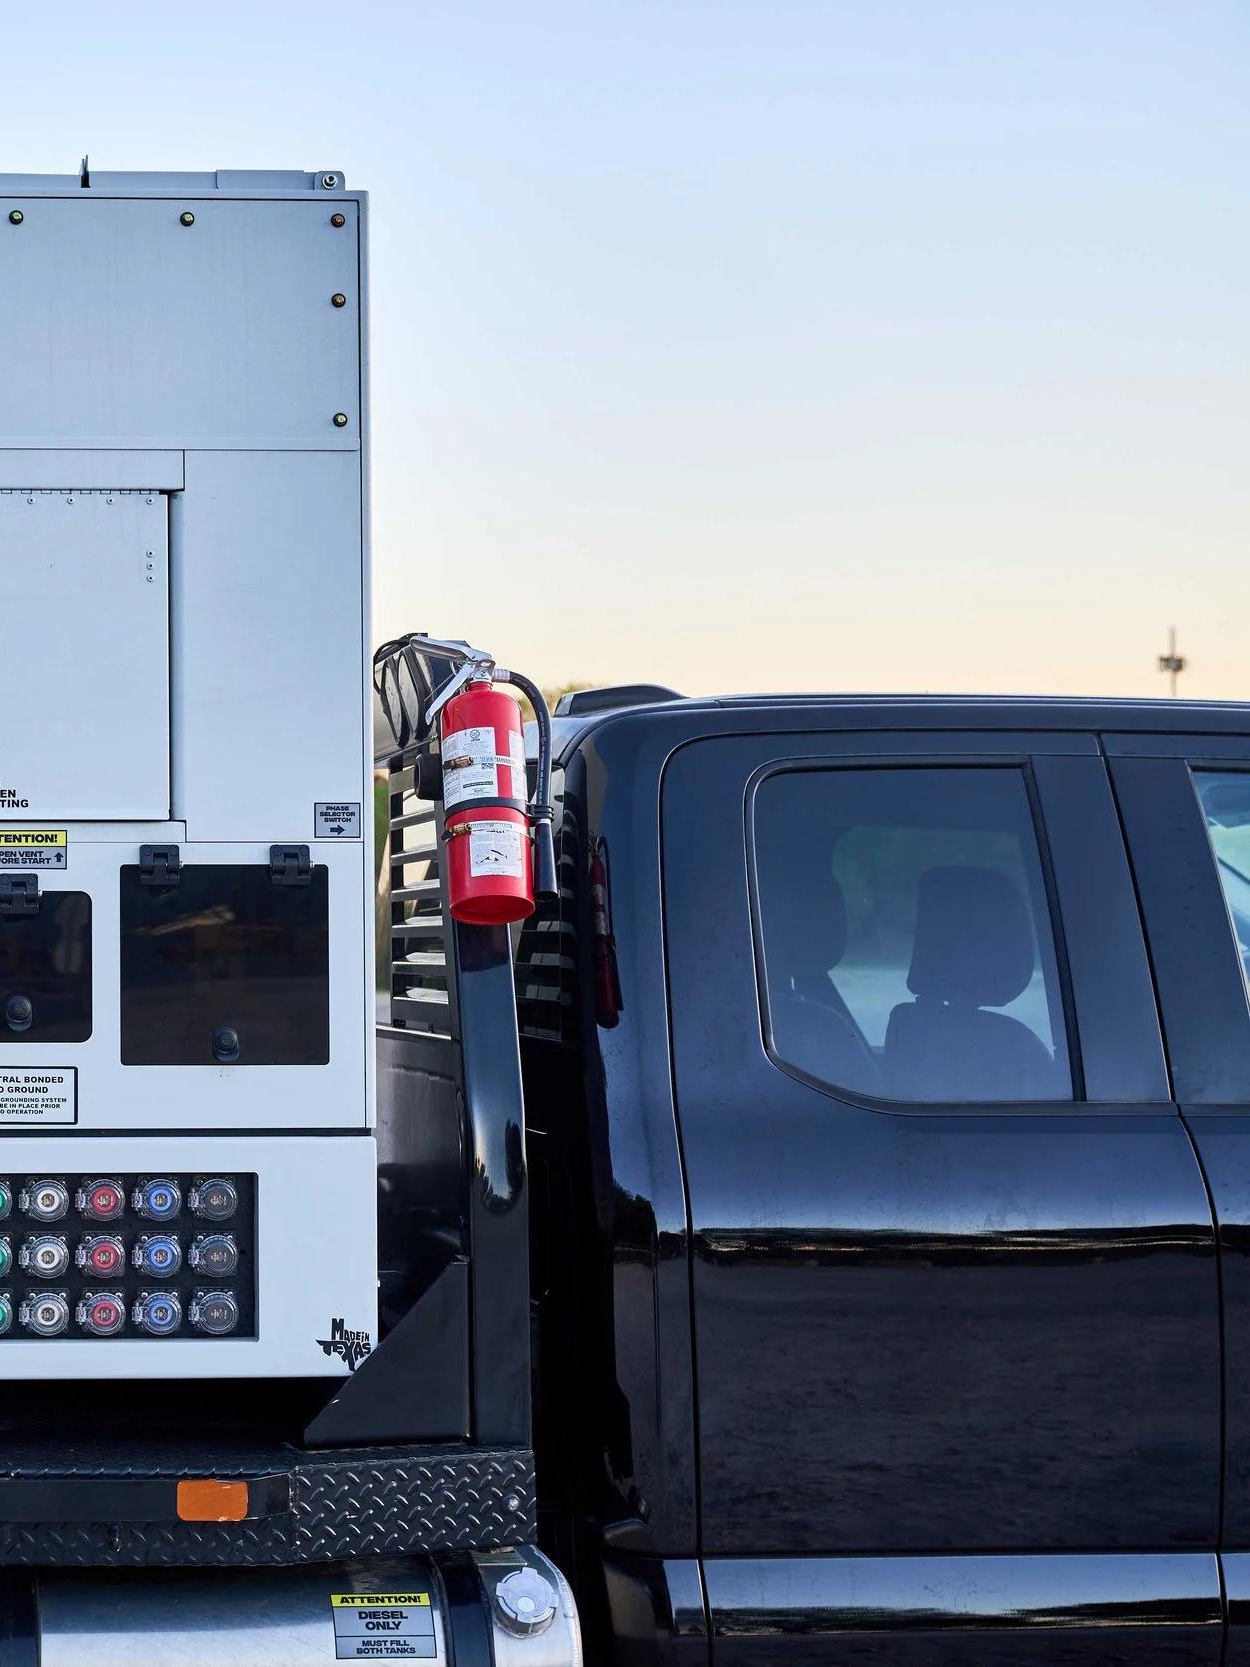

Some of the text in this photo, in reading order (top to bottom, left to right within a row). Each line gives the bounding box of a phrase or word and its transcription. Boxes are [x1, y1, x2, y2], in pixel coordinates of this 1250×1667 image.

[339, 1595, 421, 1604] ATTENTION!
[358, 1611, 408, 1619] DIESEL
[365, 1621, 401, 1630] ONLY
